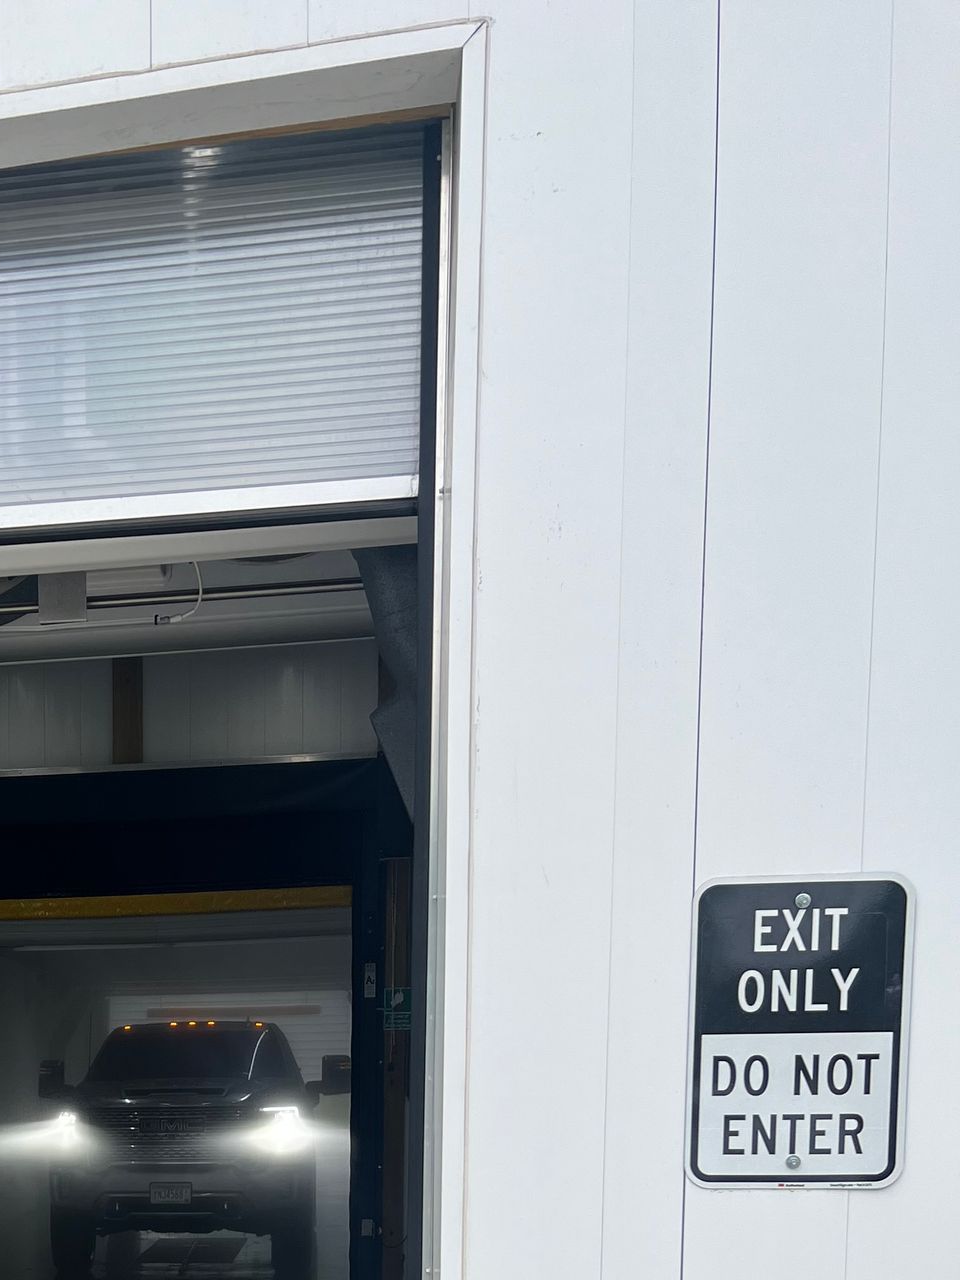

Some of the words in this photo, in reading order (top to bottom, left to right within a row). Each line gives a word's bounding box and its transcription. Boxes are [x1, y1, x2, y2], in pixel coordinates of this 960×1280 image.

[753, 908, 848, 953] EXIT
[738, 967, 860, 1013] ONLY
[711, 1054, 770, 1097] DO
[793, 1053, 880, 1096] NOT
[722, 1113, 864, 1155] ENTER
